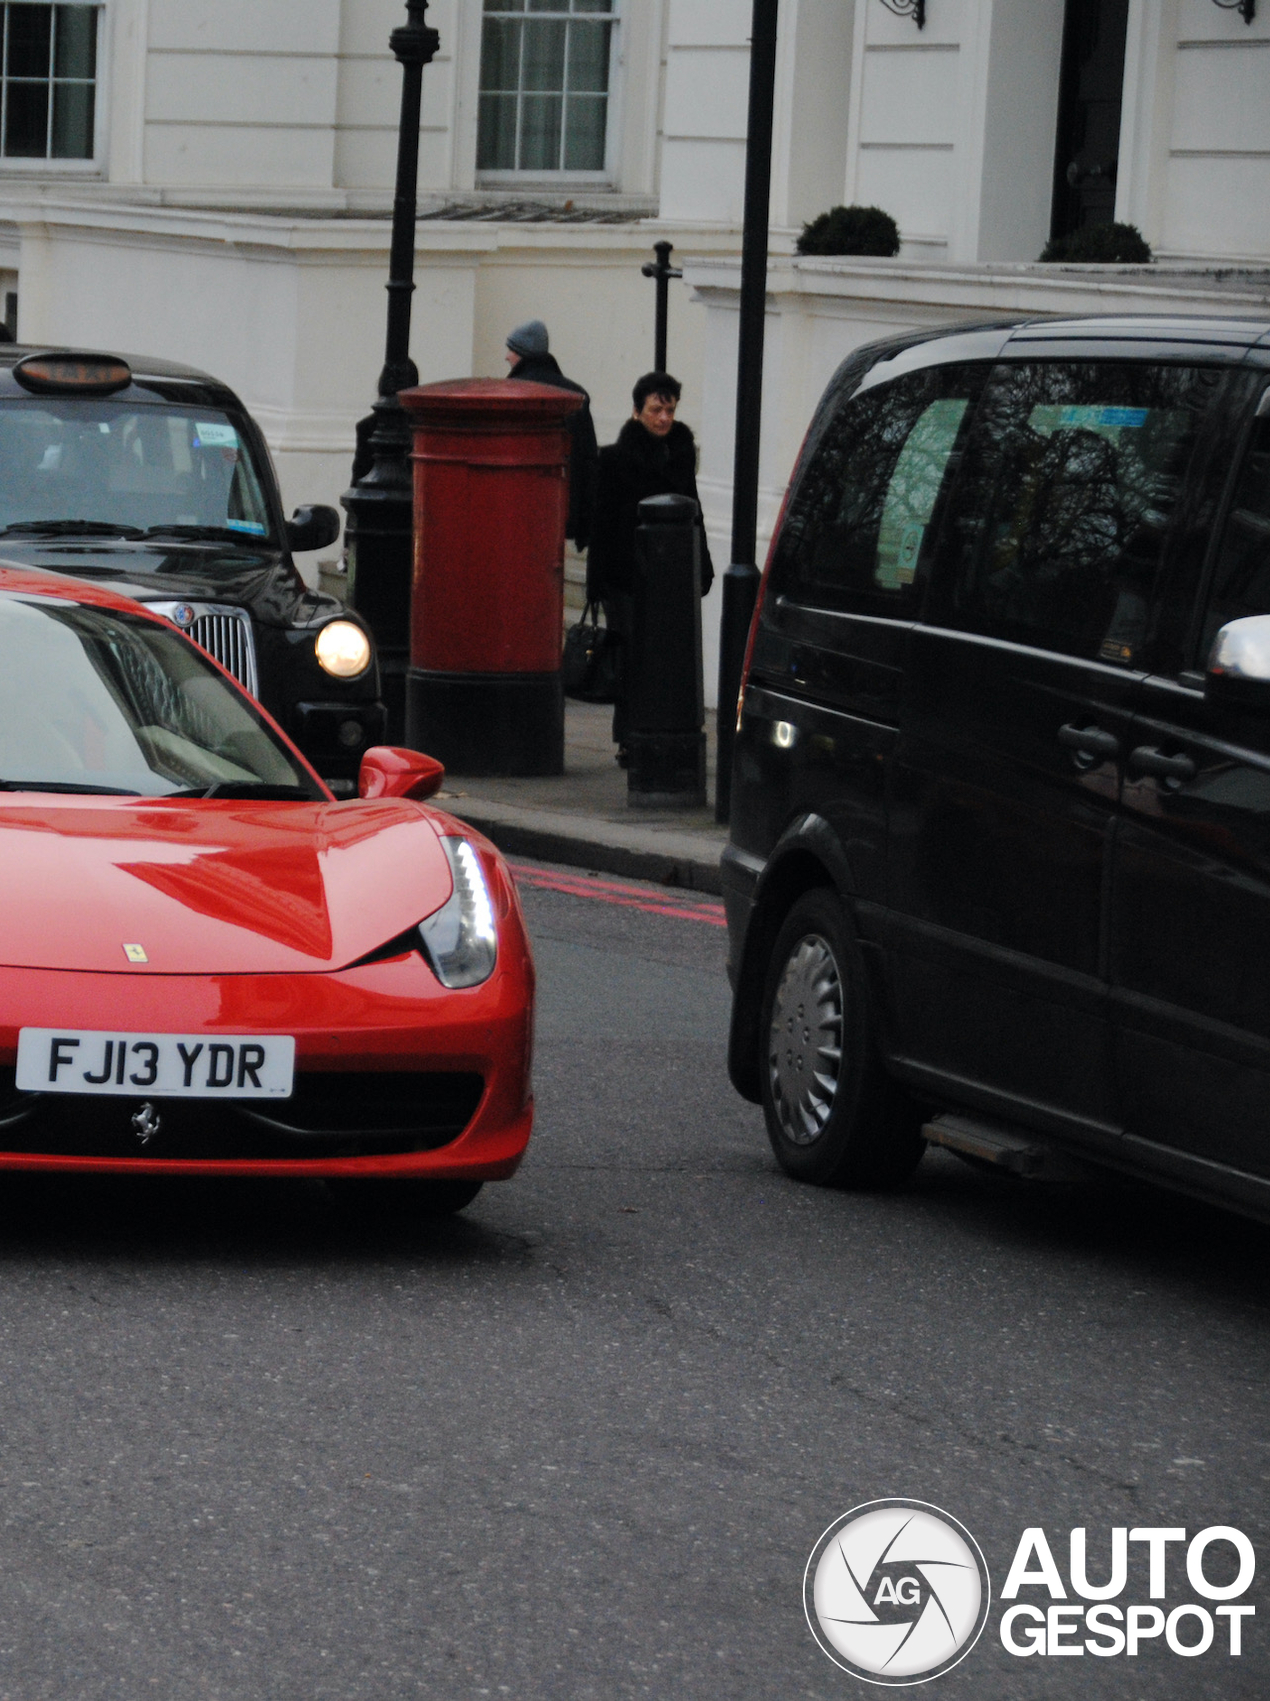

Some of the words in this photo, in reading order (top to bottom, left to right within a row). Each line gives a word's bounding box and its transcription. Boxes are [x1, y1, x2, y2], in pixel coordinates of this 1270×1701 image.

[42, 361, 113, 383] TAXI
[48, 1037, 159, 1086] FJ13
[176, 1043, 266, 1088] YDR
